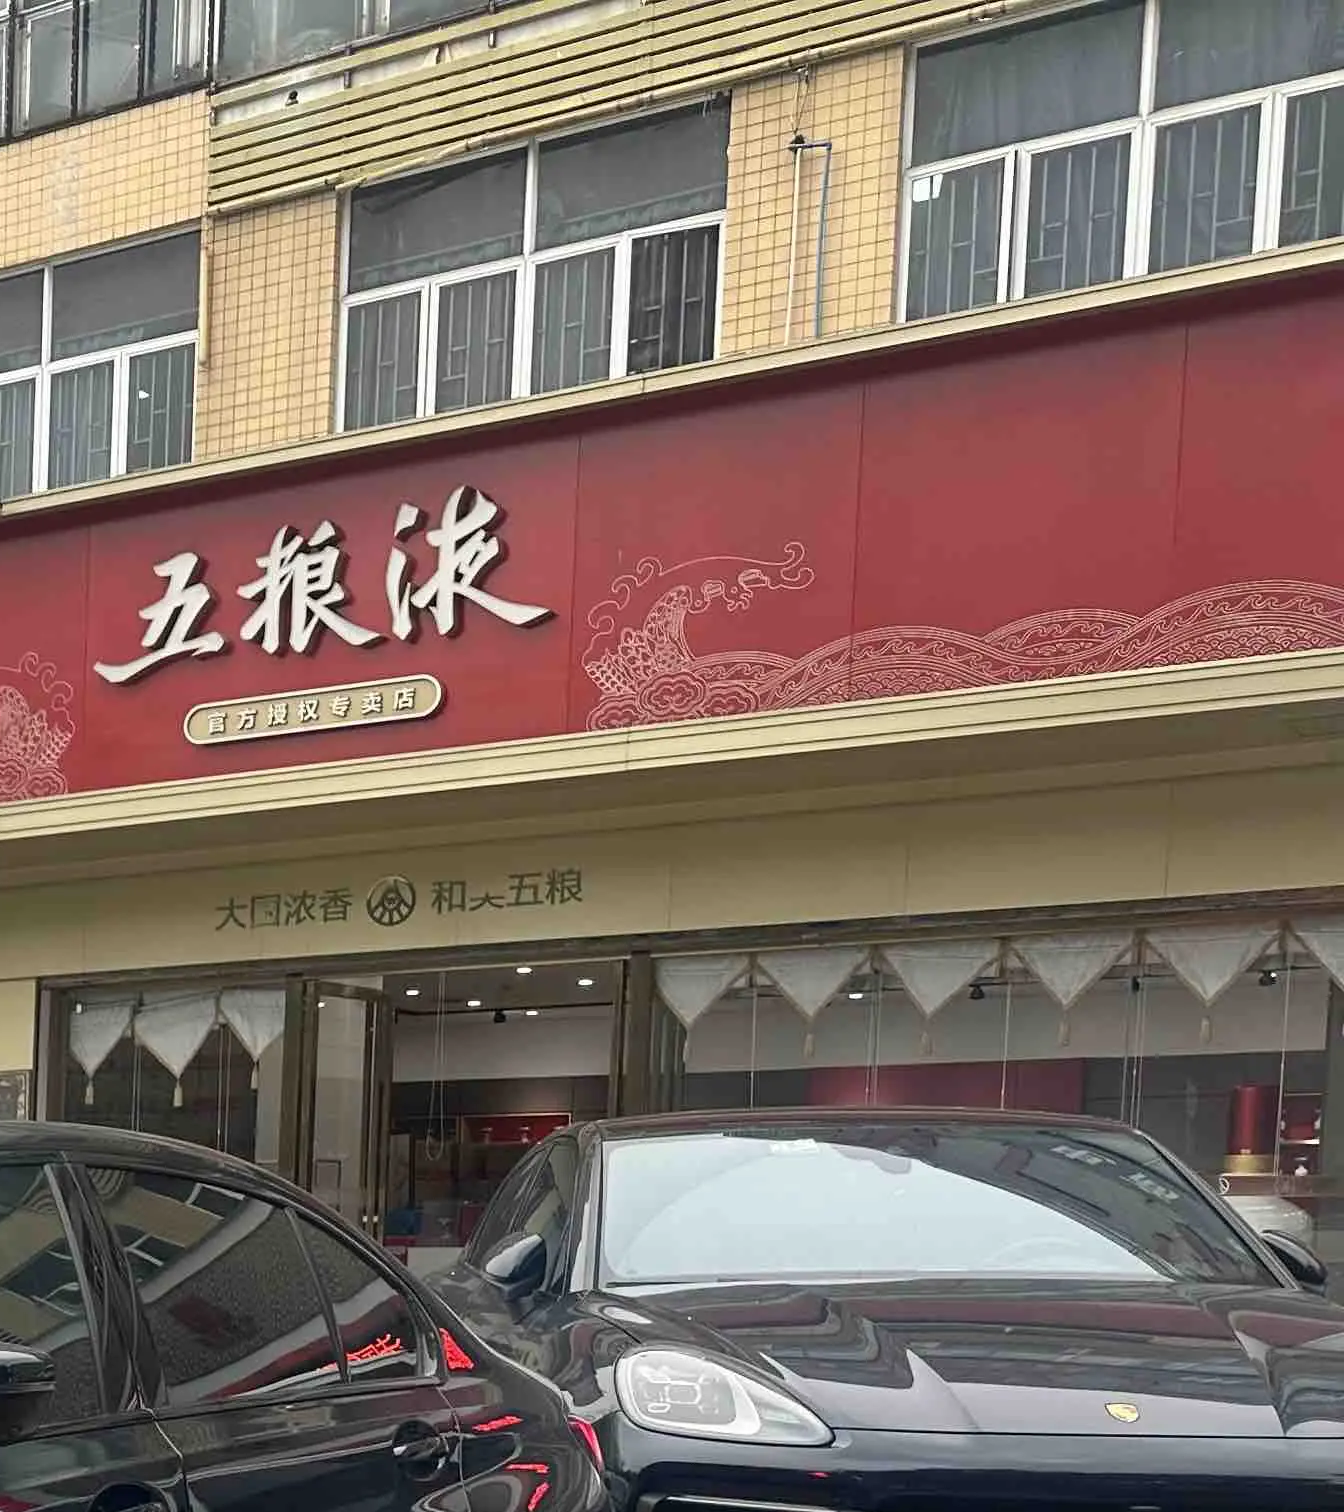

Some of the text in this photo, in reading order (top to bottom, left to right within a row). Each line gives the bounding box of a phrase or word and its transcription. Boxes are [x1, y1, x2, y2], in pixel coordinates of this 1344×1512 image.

[93, 484, 554, 683] 五粮液
[207, 687, 416, 735] 官方授权专卖店
